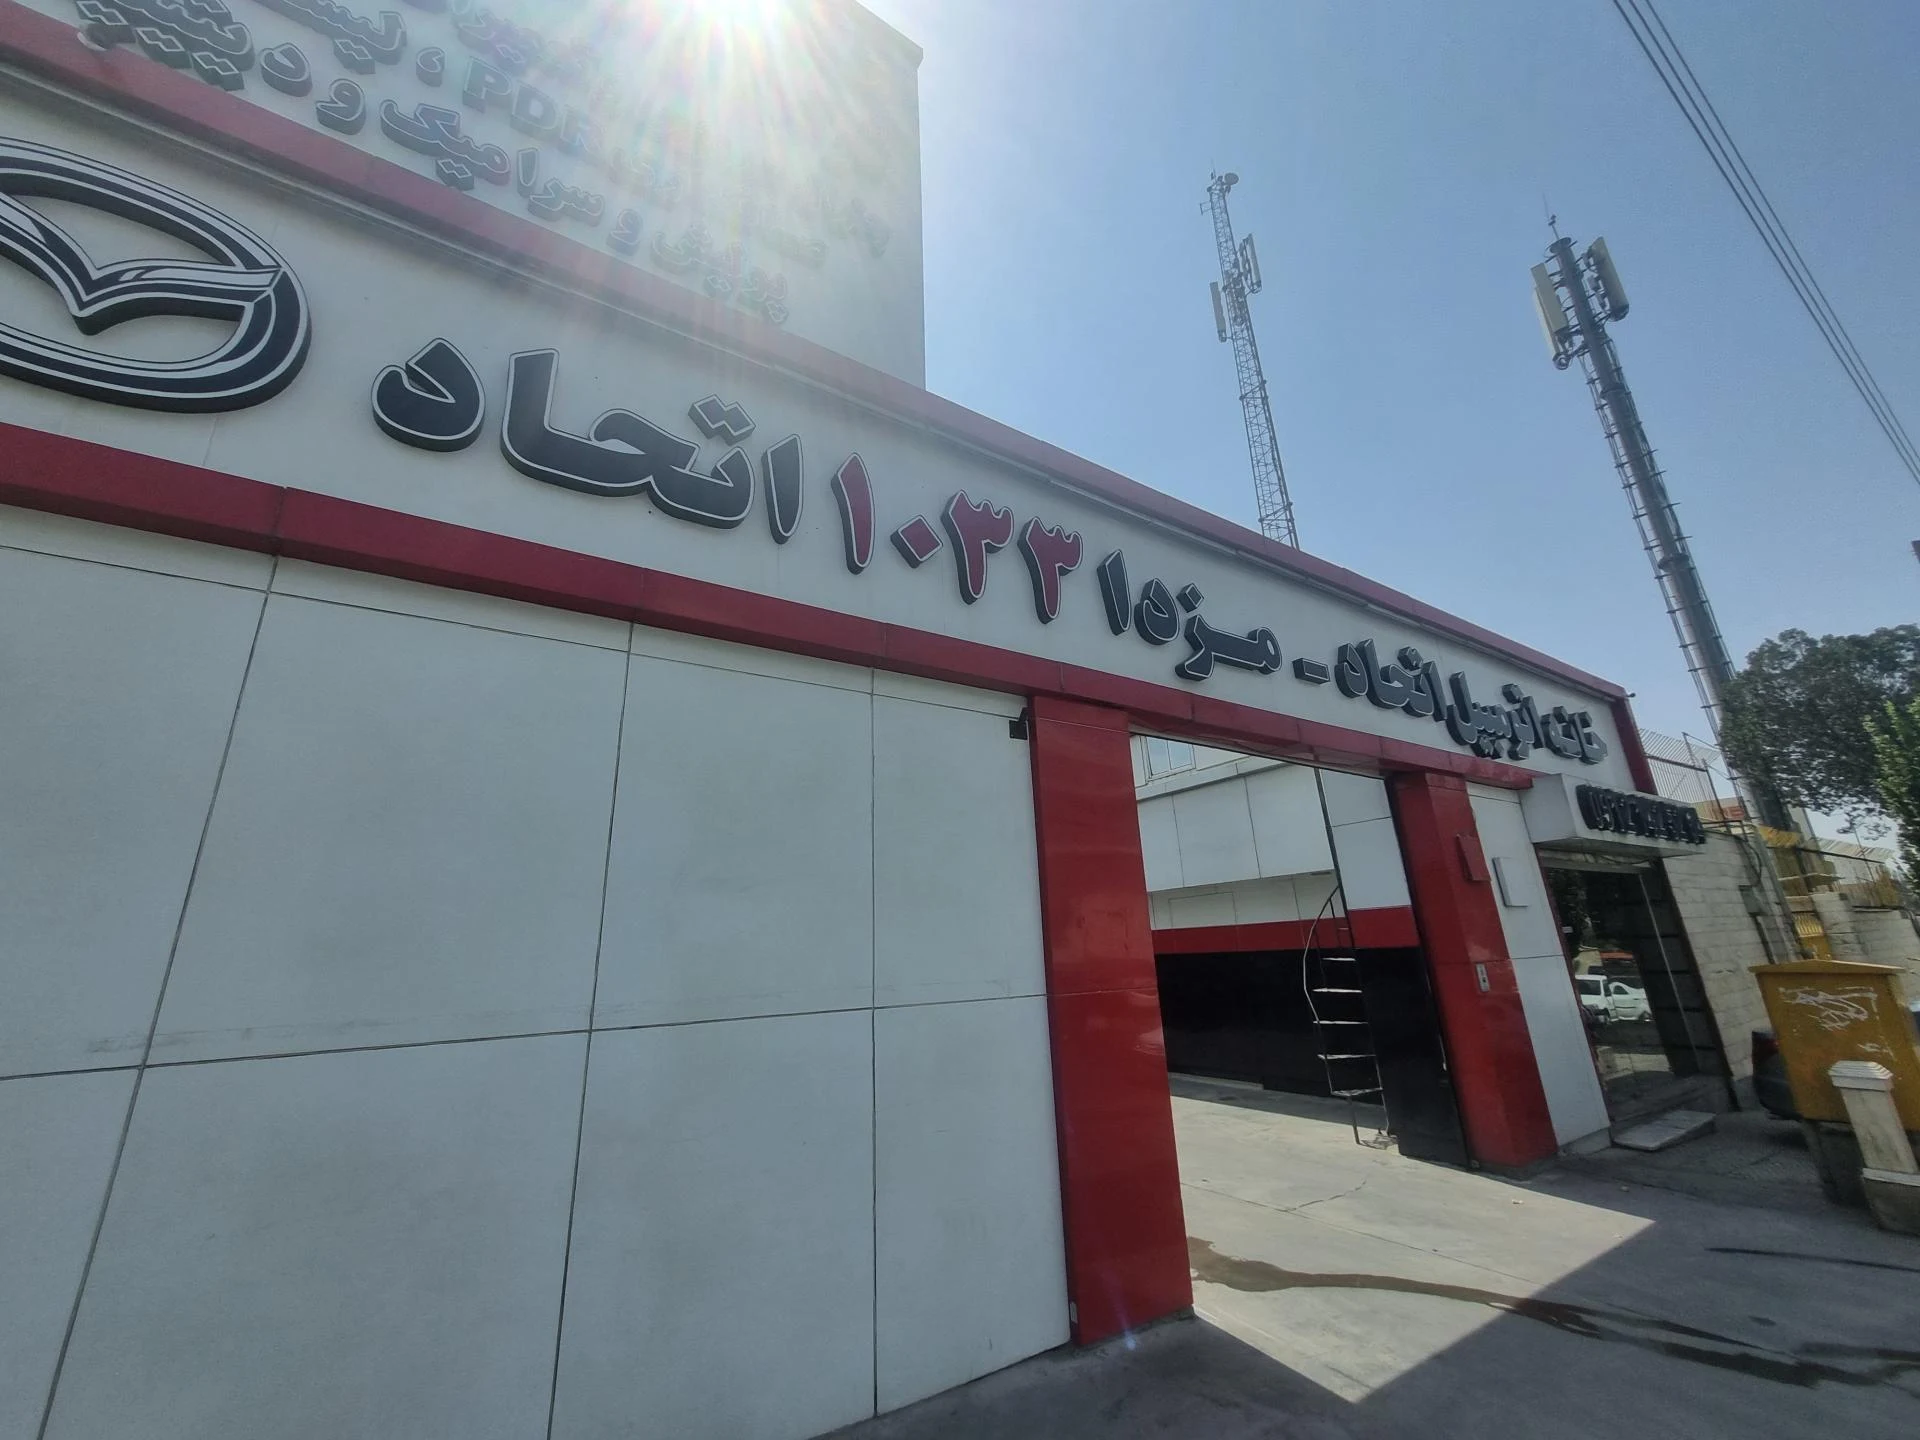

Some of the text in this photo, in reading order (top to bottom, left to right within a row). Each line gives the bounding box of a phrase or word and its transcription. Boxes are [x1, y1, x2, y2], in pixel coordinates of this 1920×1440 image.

[316, 78, 366, 135] و
[379, 99, 606, 226] سرامیک
[606, 208, 643, 254] و
[371, 337, 804, 545] اتحاد
[830, 452, 1084, 624] ۱۰۳۳
[1097, 549, 1282, 681] مزدا
[1336, 638, 1445, 722] اتحاد
[1446, 670, 1544, 761] اتومبیل
[1542, 705, 1608, 764] خانه
